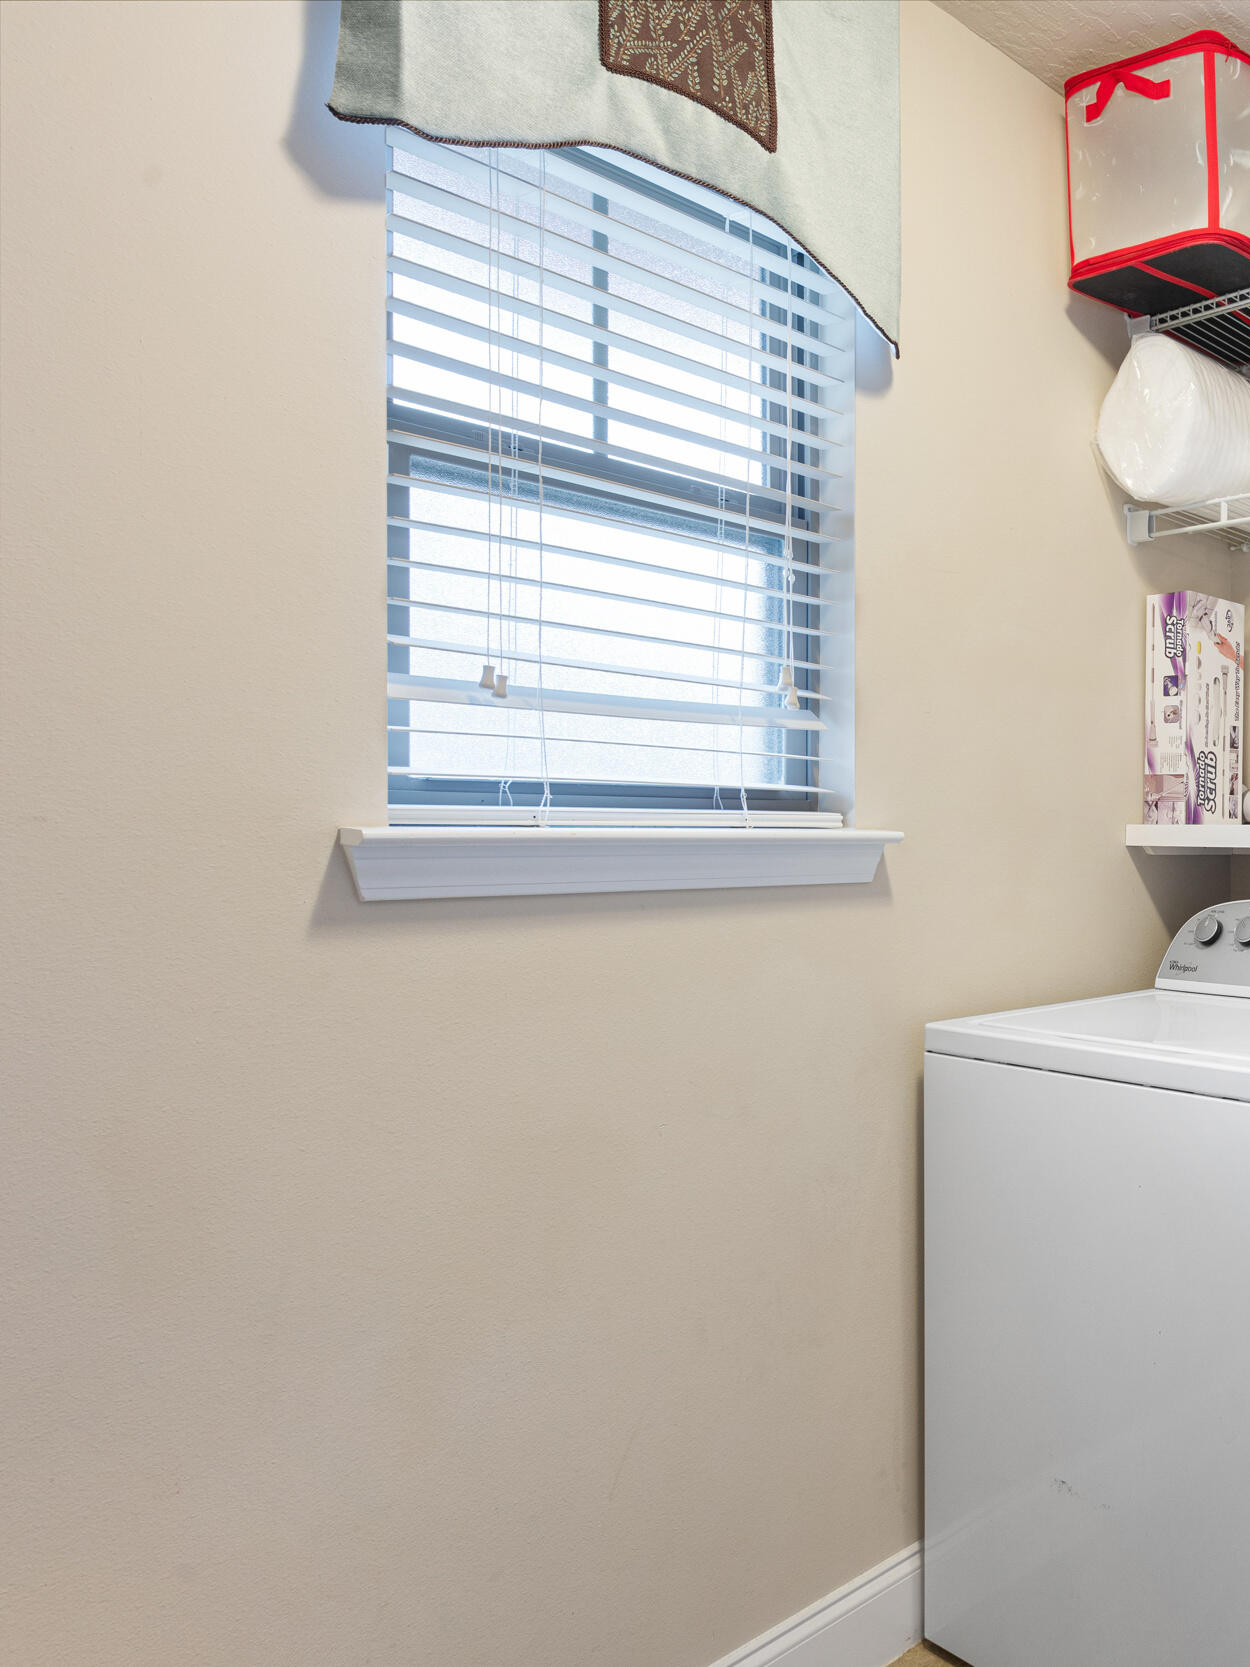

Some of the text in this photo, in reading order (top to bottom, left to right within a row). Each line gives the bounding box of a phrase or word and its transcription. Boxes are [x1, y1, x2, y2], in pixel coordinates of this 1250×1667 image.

[1165, 615, 1177, 659] Scrub
[1176, 618, 1185, 658] Tornado
[1196, 750, 1206, 807] Tornado
[1204, 751, 1217, 815] Scrub
[1168, 963, 1198, 974] Whirlpool
